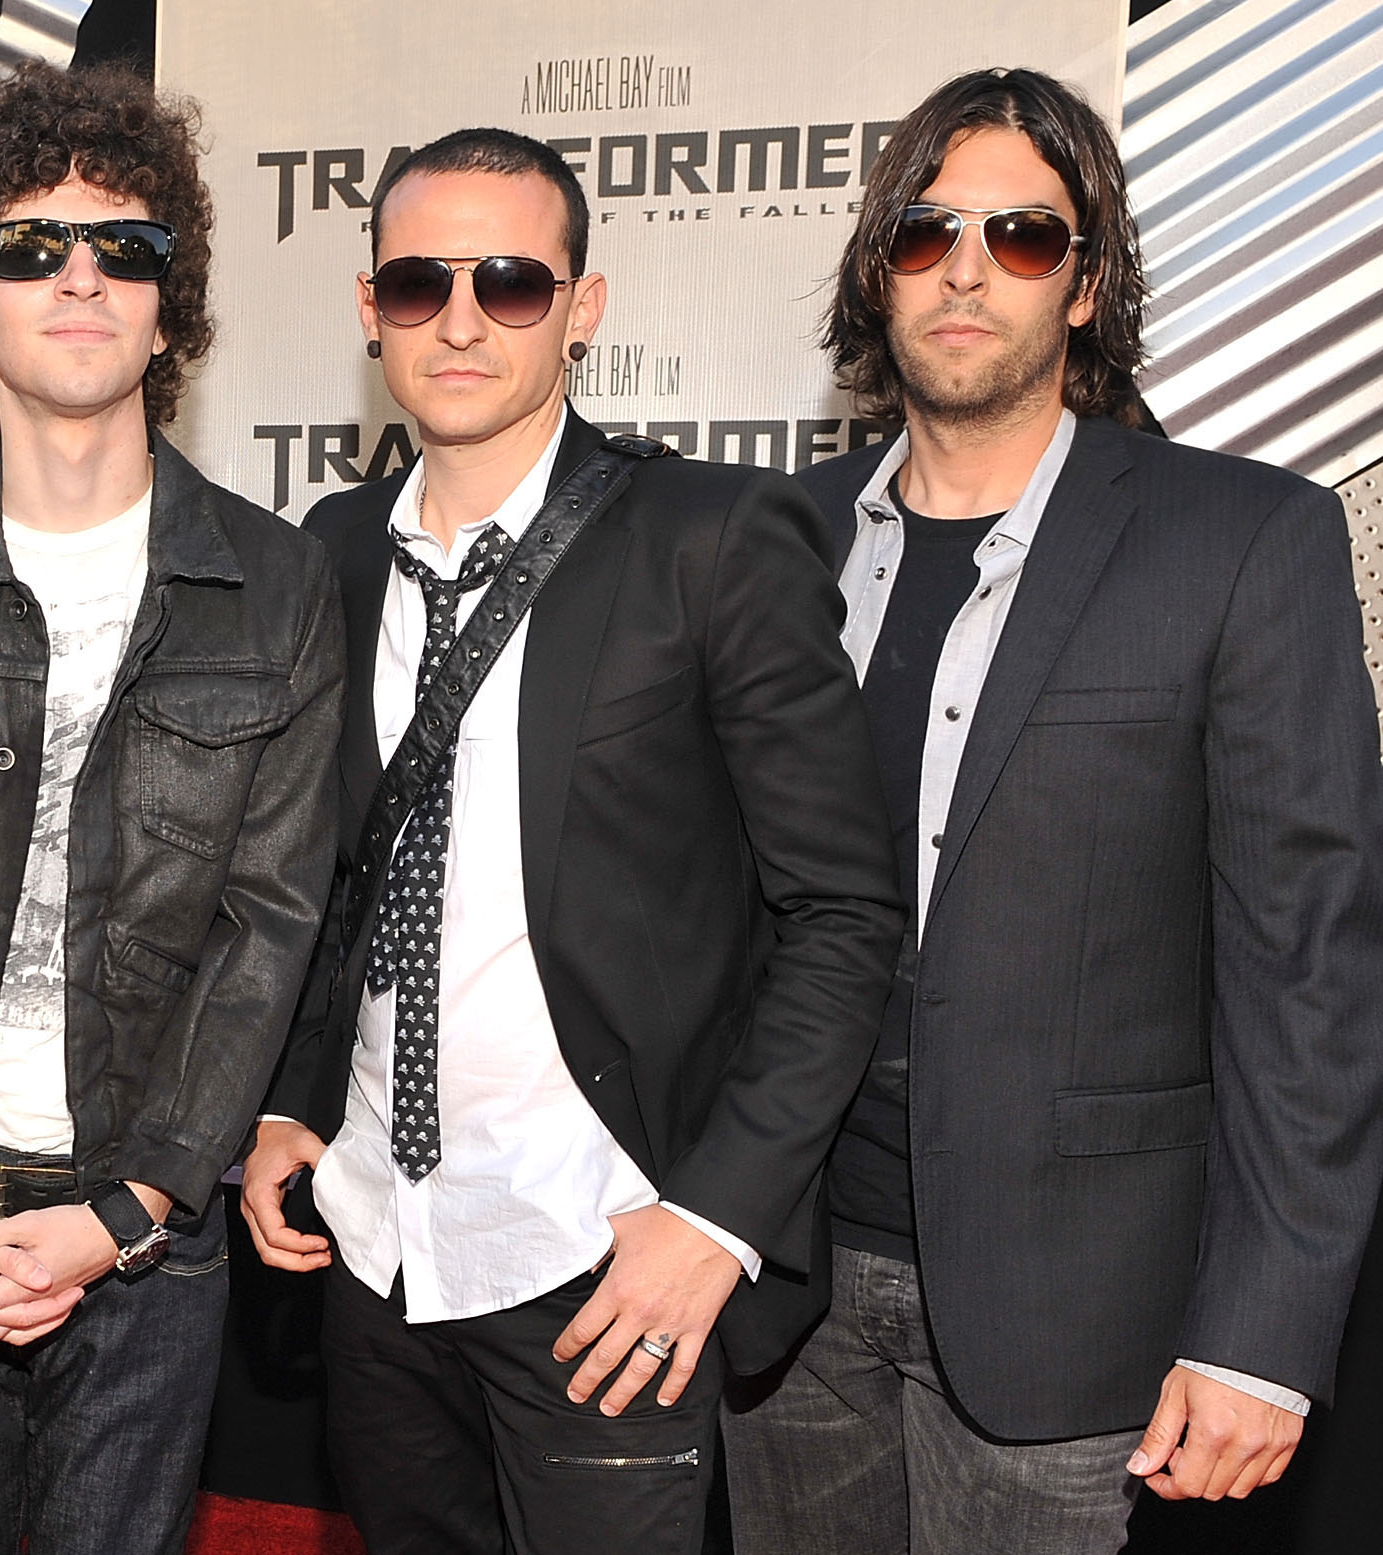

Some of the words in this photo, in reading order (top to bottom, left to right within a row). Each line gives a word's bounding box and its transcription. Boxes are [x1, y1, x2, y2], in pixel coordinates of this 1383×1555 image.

[521, 75, 531, 115] A
[536, 57, 613, 114] MICHAEL
[619, 55, 655, 110] BAY
[658, 66, 691, 107] FILM
[601, 211, 617, 224] F
[643, 208, 711, 223] THE
[739, 201, 865, 219] FALLE
[610, 344, 644, 397] BAY
